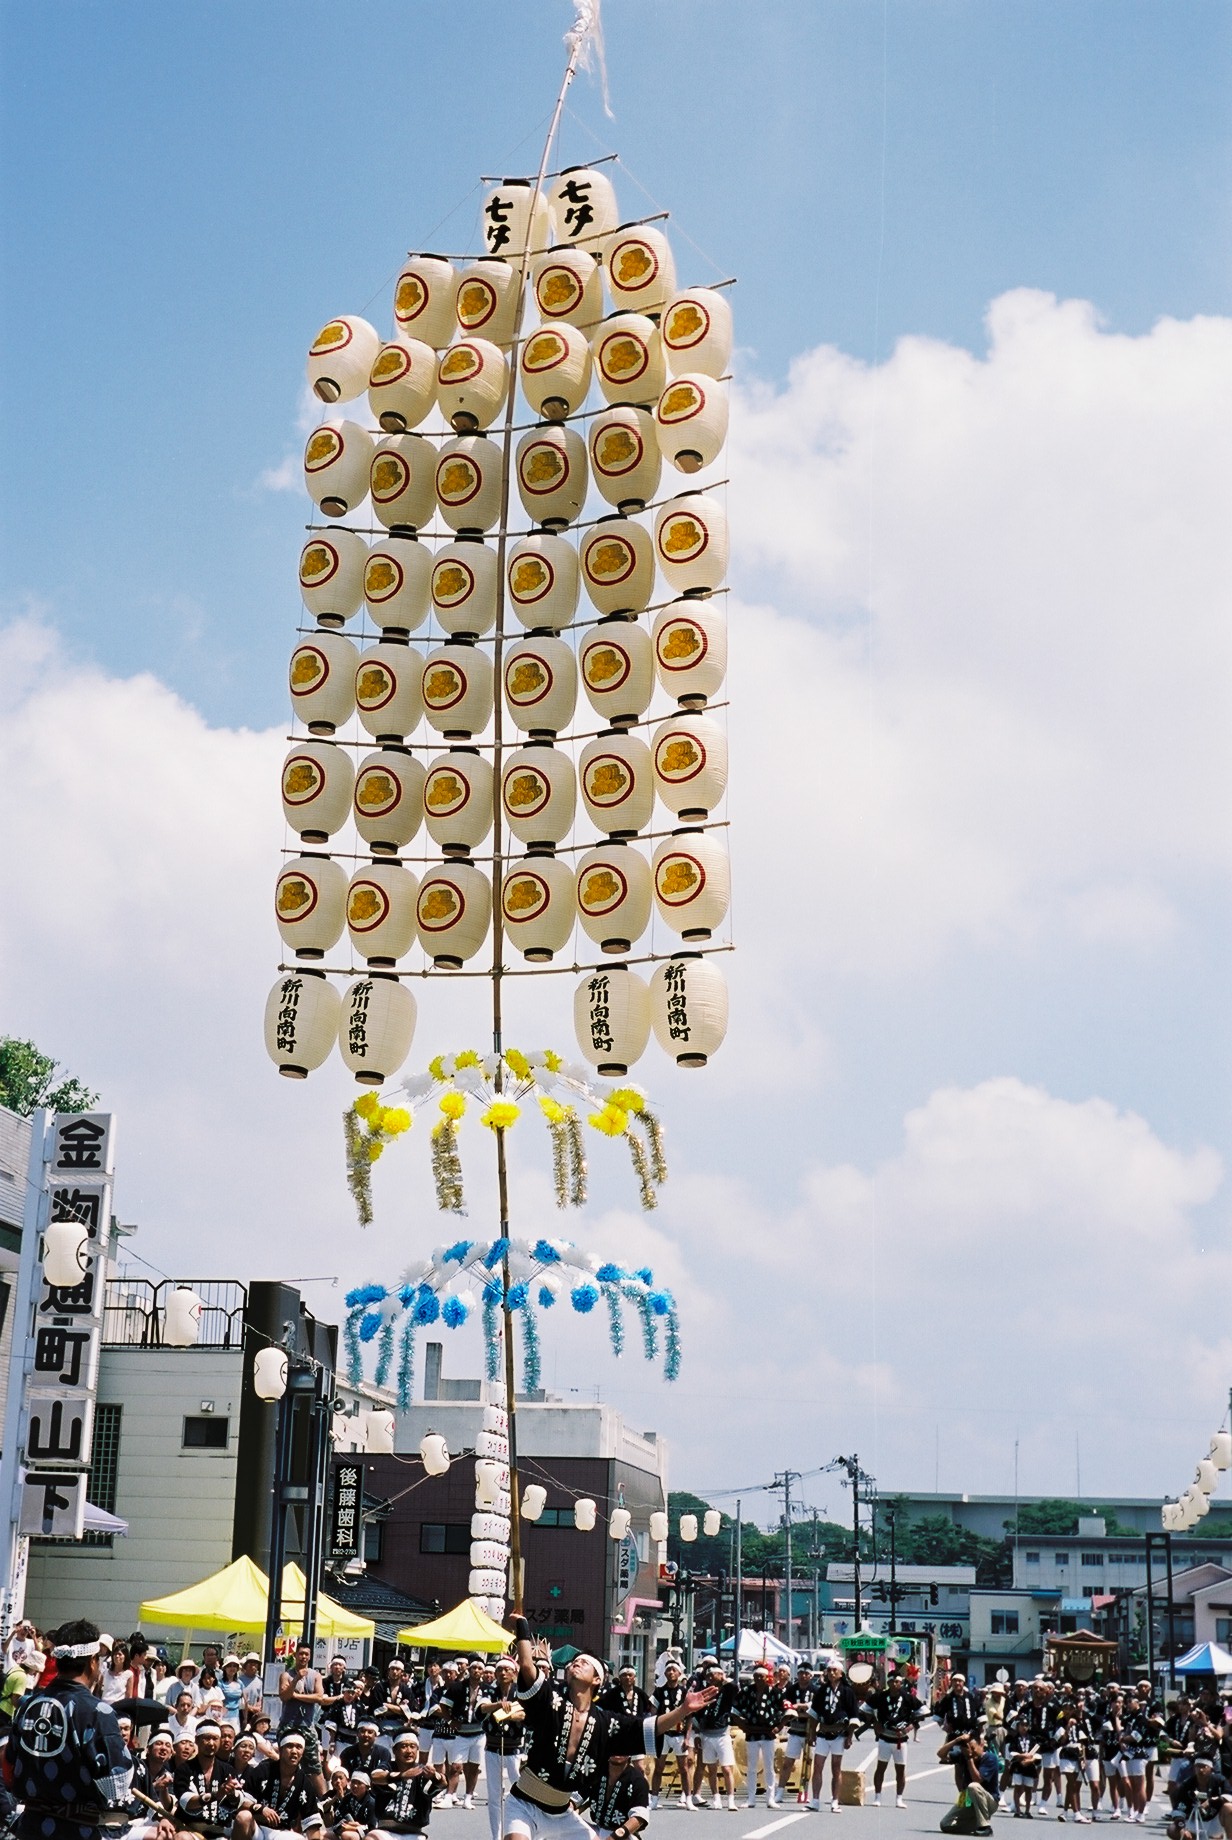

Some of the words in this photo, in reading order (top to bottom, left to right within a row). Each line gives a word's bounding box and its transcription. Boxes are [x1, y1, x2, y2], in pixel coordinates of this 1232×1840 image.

[485, 196, 513, 253] 七夕
[558, 180, 594, 236] 七夕
[277, 979, 303, 1053] 新川向南町
[349, 981, 373, 1057] 新川向南町
[588, 976, 614, 1052] 新川向南町
[664, 963, 691, 1042] 新川向南町
[336, 1467, 357, 1547] 後藤歯科
